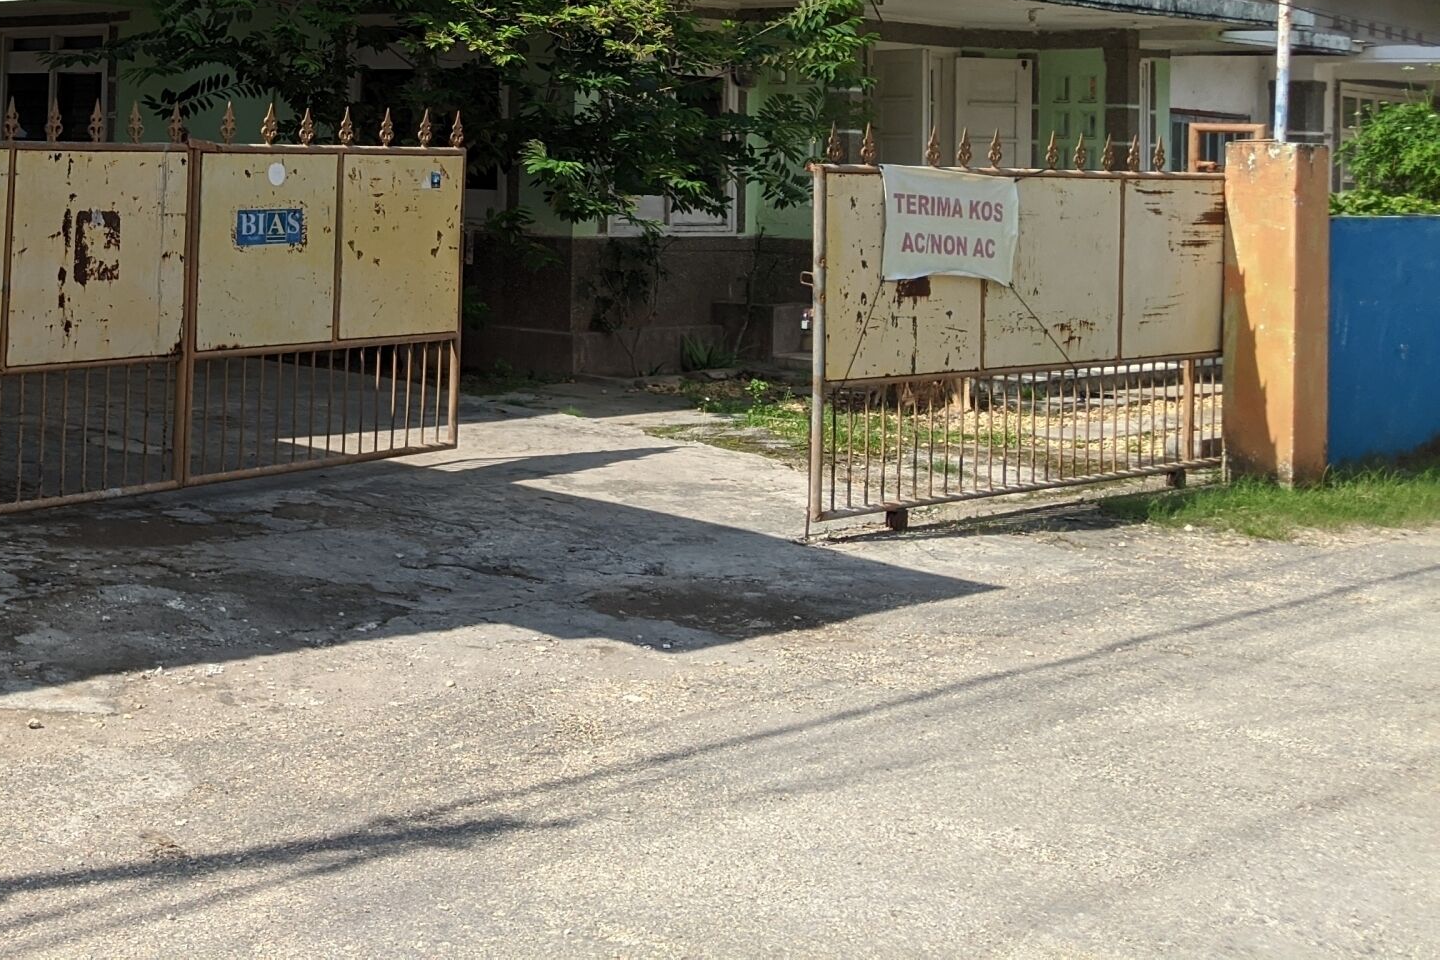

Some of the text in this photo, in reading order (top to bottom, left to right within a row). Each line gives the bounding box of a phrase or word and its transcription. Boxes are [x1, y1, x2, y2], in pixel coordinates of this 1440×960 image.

[893, 193, 1003, 222] TERIMA KOS
[240, 211, 300, 235] BIAS
[901, 232, 996, 259] AC/NON AC
